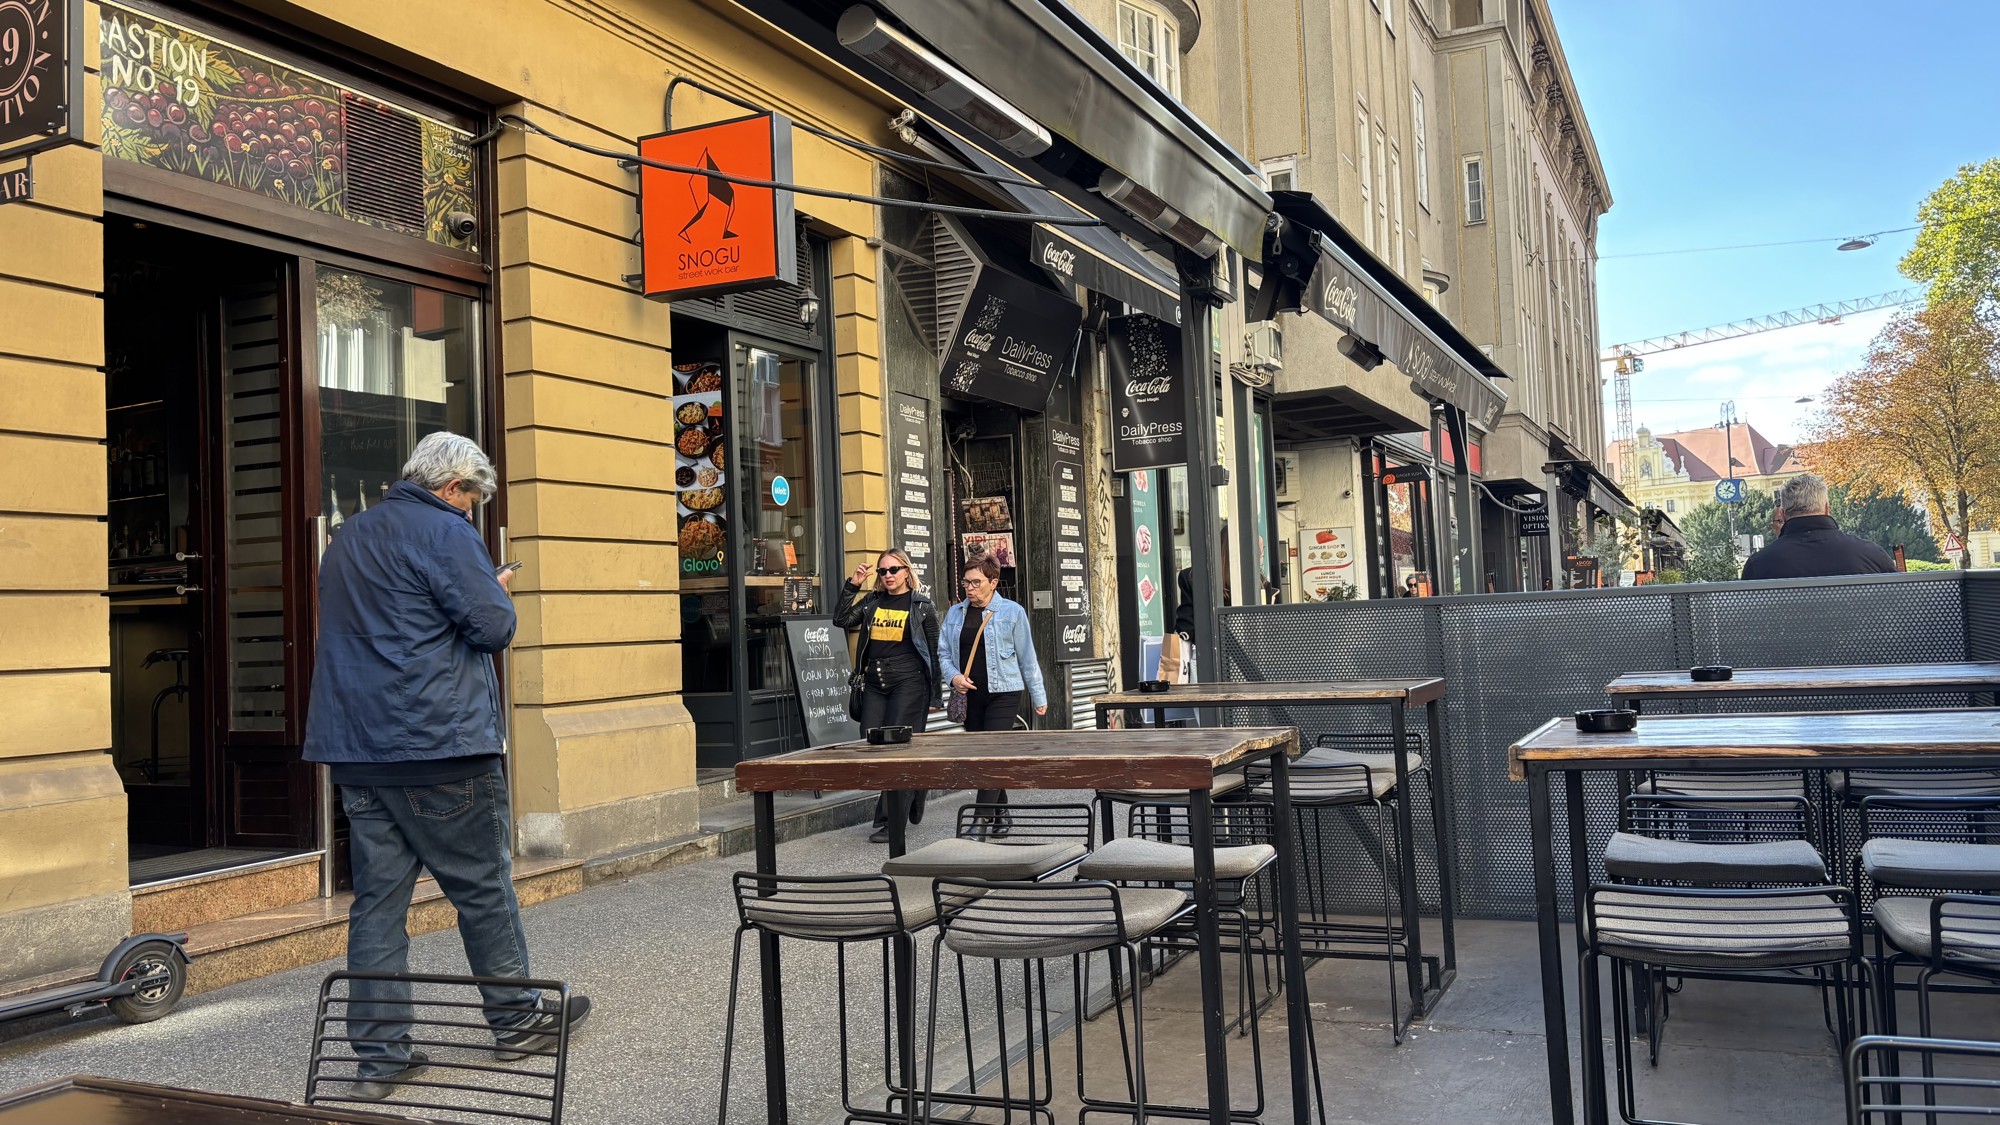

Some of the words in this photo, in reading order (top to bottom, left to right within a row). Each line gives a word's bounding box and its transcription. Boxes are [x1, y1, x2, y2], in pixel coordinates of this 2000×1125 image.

[0, 27, 20, 67] 9
[174, 75, 200, 107] 19
[678, 245, 740, 271] SNOGU
[678, 270, 703, 281] street
[704, 266, 724, 276] wok
[725, 264, 740, 274] bar
[1001, 335, 1054, 369] DailyPress
[1003, 363, 1025, 379] Tobacco
[1025, 372, 1038, 383] shop
[899, 403, 925, 419] DailyPress
[1121, 421, 1183, 437] DailyPress
[1052, 429, 1080, 447] DailyPress
[1132, 438, 1157, 446] Tobacco
[1522, 522, 1550, 530] OPTIKA
[1523, 514, 1549, 522] VISION
[683, 558, 719, 572] Glovo
[801, 669, 822, 682] CORN
[824, 668, 839, 681] DOG
[808, 705, 826, 719] ASIAN
